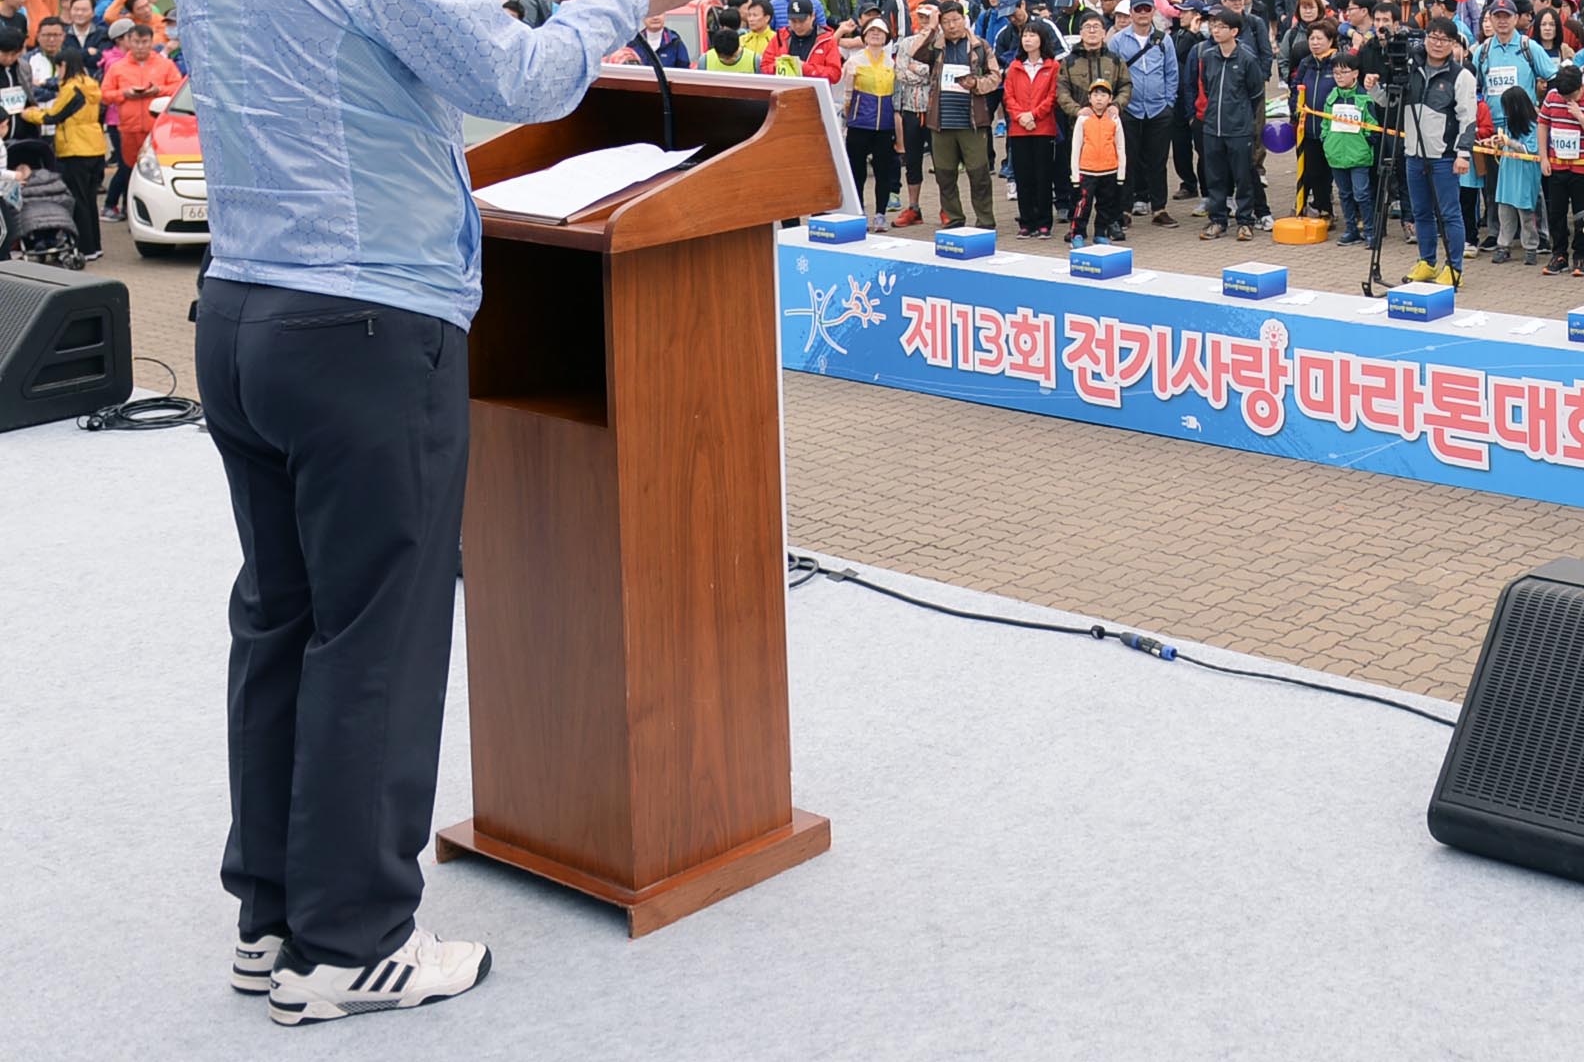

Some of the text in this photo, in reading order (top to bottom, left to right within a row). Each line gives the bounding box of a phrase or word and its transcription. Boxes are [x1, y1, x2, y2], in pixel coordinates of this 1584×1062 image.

[1489, 76, 1515, 87] 16325
[189, 206, 208, 219] 66
[900, 293, 1057, 391] 제13회
[1063, 313, 1292, 436] 전기사랑
